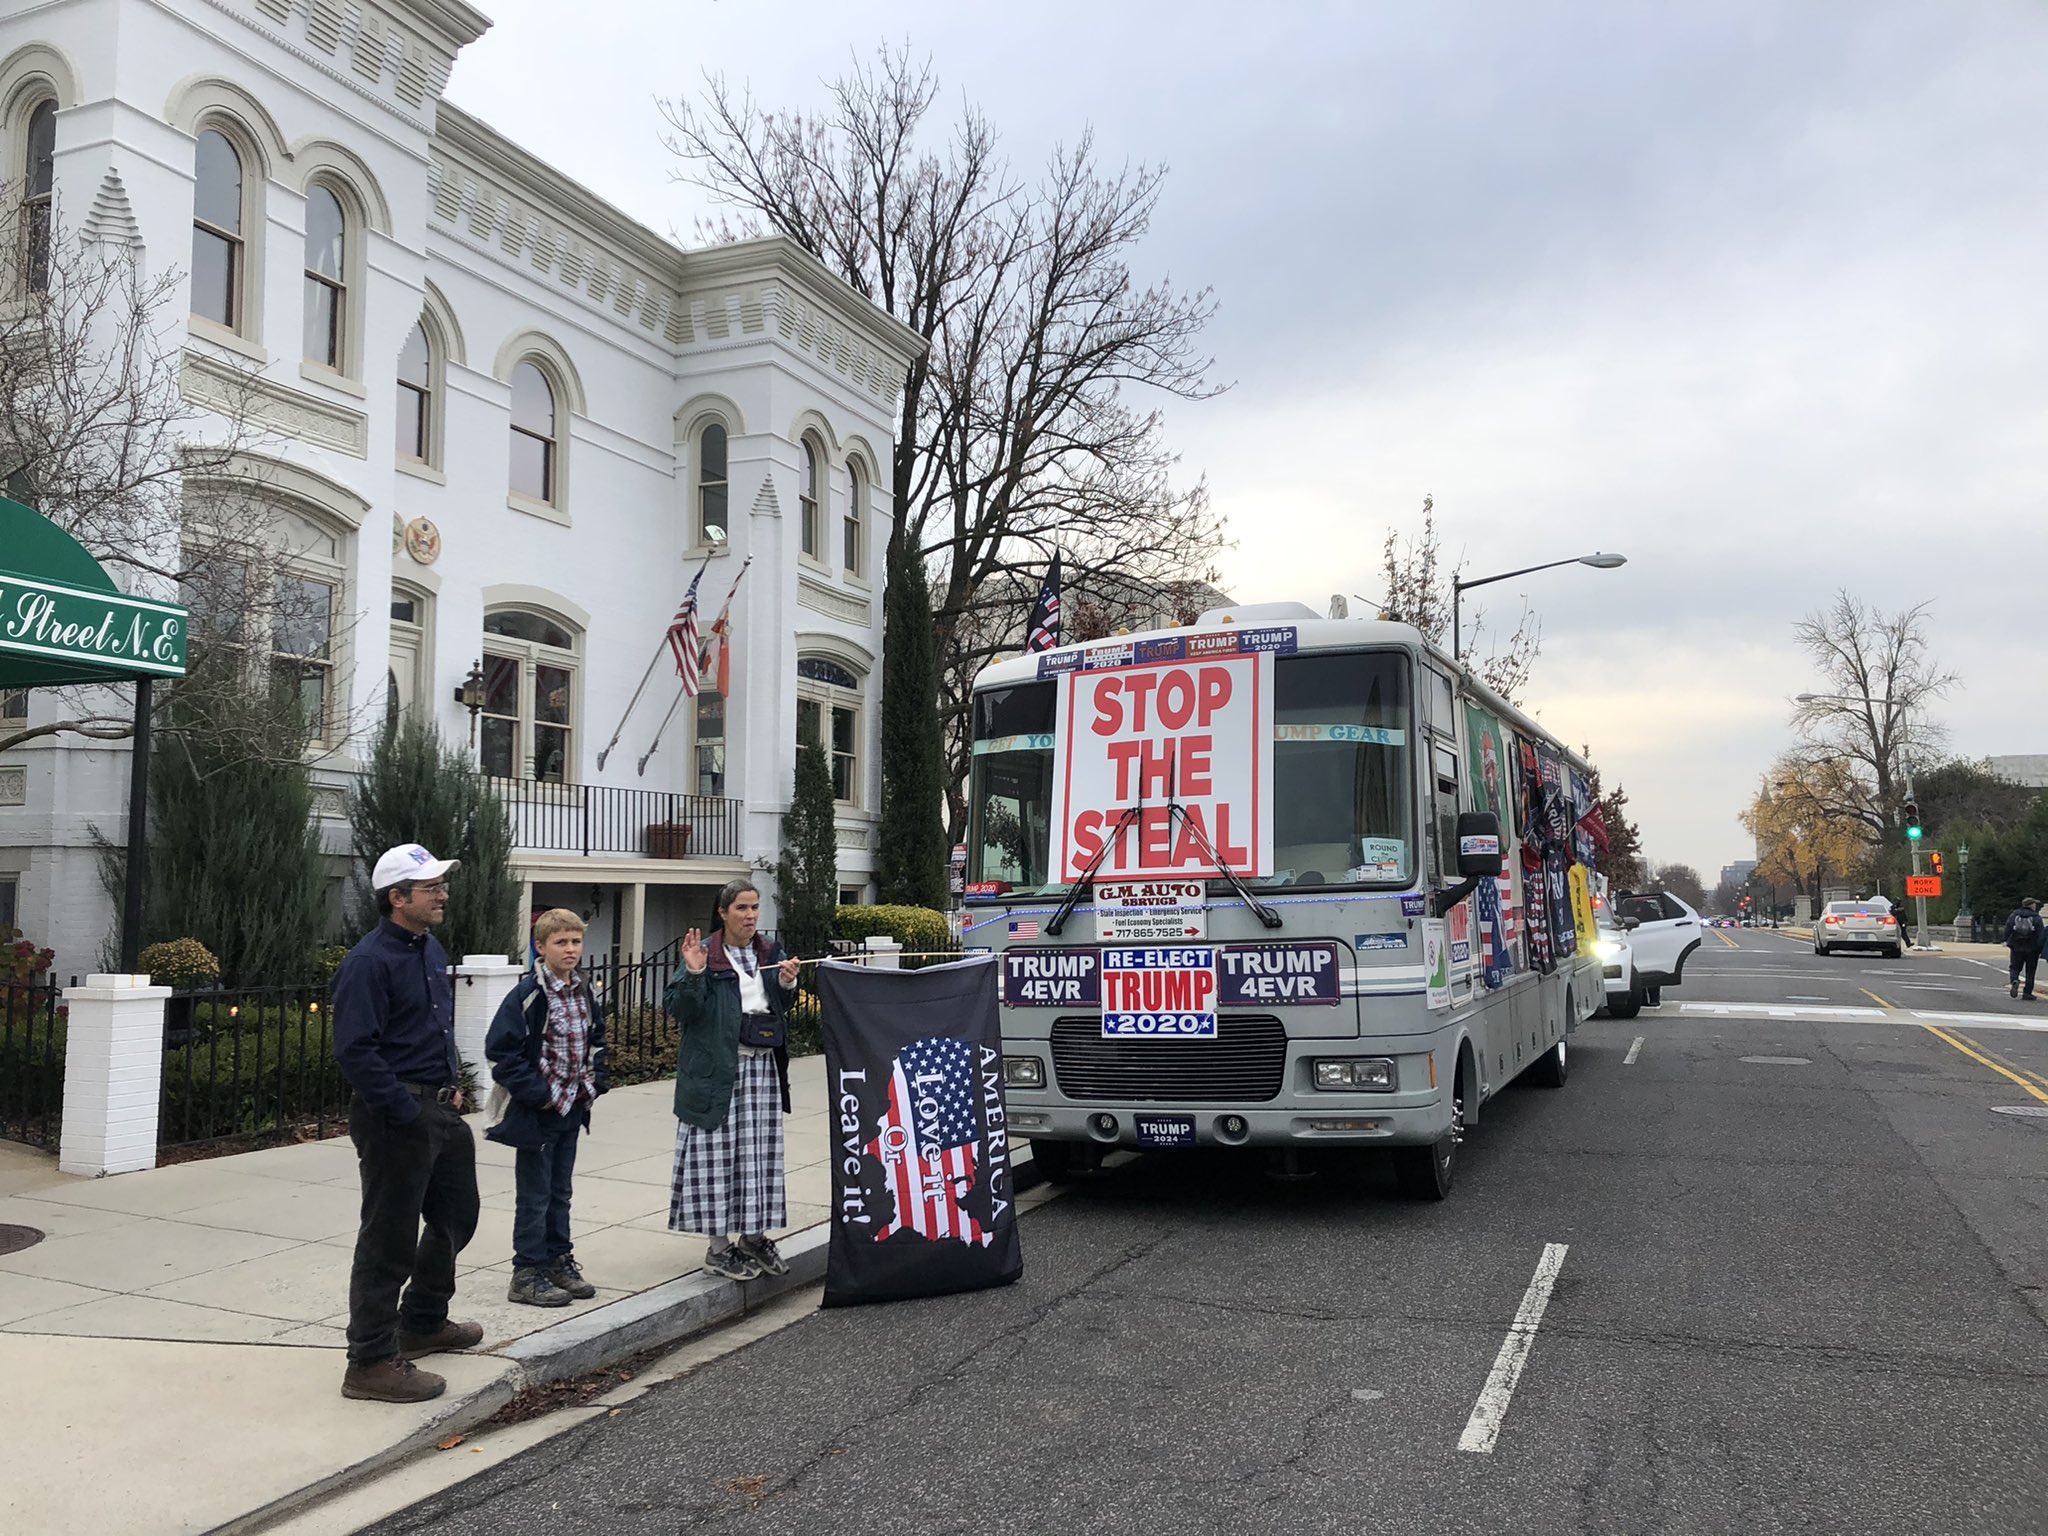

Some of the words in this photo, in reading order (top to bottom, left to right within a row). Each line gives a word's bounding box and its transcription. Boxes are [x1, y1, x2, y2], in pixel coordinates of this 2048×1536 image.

[7, 592, 114, 651] Street
[1189, 636, 1237, 650] TRUMP
[1242, 631, 1293, 645] TRUMP
[1254, 643, 1280, 651] 2020
[1091, 645, 1128, 656] TRUMP
[1139, 644, 1180, 658] TRUMP
[1045, 654, 1078, 666] TRUMP
[1093, 659, 1121, 669] 2020
[1091, 666, 1232, 736] STOP
[987, 735, 1017, 751] GET
[1027, 735, 1055, 748] YO
[1274, 725, 1322, 740] UMP
[1329, 726, 1391, 743] GEAR
[1107, 735, 1213, 801] THE
[1071, 803, 1248, 871] STEAL
[1370, 844, 1398, 853] ROUND
[980, 884, 996, 892] 2020
[1141, 884, 1201, 897] AUTO
[1122, 897, 1177, 906] SERVICE
[1404, 901, 1424, 909] TRUMP
[1100, 909, 1114, 917] State
[1115, 908, 1143, 918] Inspection
[1149, 907, 1180, 917] Emergency
[1181, 906, 1202, 915] Service
[1127, 918, 1151, 926] Economy
[1152, 917, 1183, 926] Specialists
[1008, 956, 1095, 978] TRUMP
[1112, 950, 1209, 968] RE-ELECT
[1221, 950, 1333, 975] TRUMP
[1021, 980, 1081, 999] 4EVR
[1104, 970, 1214, 1011] TRUMP
[1240, 976, 1317, 998] 4EVR
[1117, 1014, 1199, 1033] 2020
[839, 1068, 866, 1176] Leave
[914, 1070, 945, 1164] Love
[979, 1044, 1010, 1222] AMERICA
[1140, 1123, 1190, 1135] TRUMP
[884, 1124, 909, 1165] Or
[922, 1171, 953, 1203] it
[842, 1187, 872, 1225] it!
